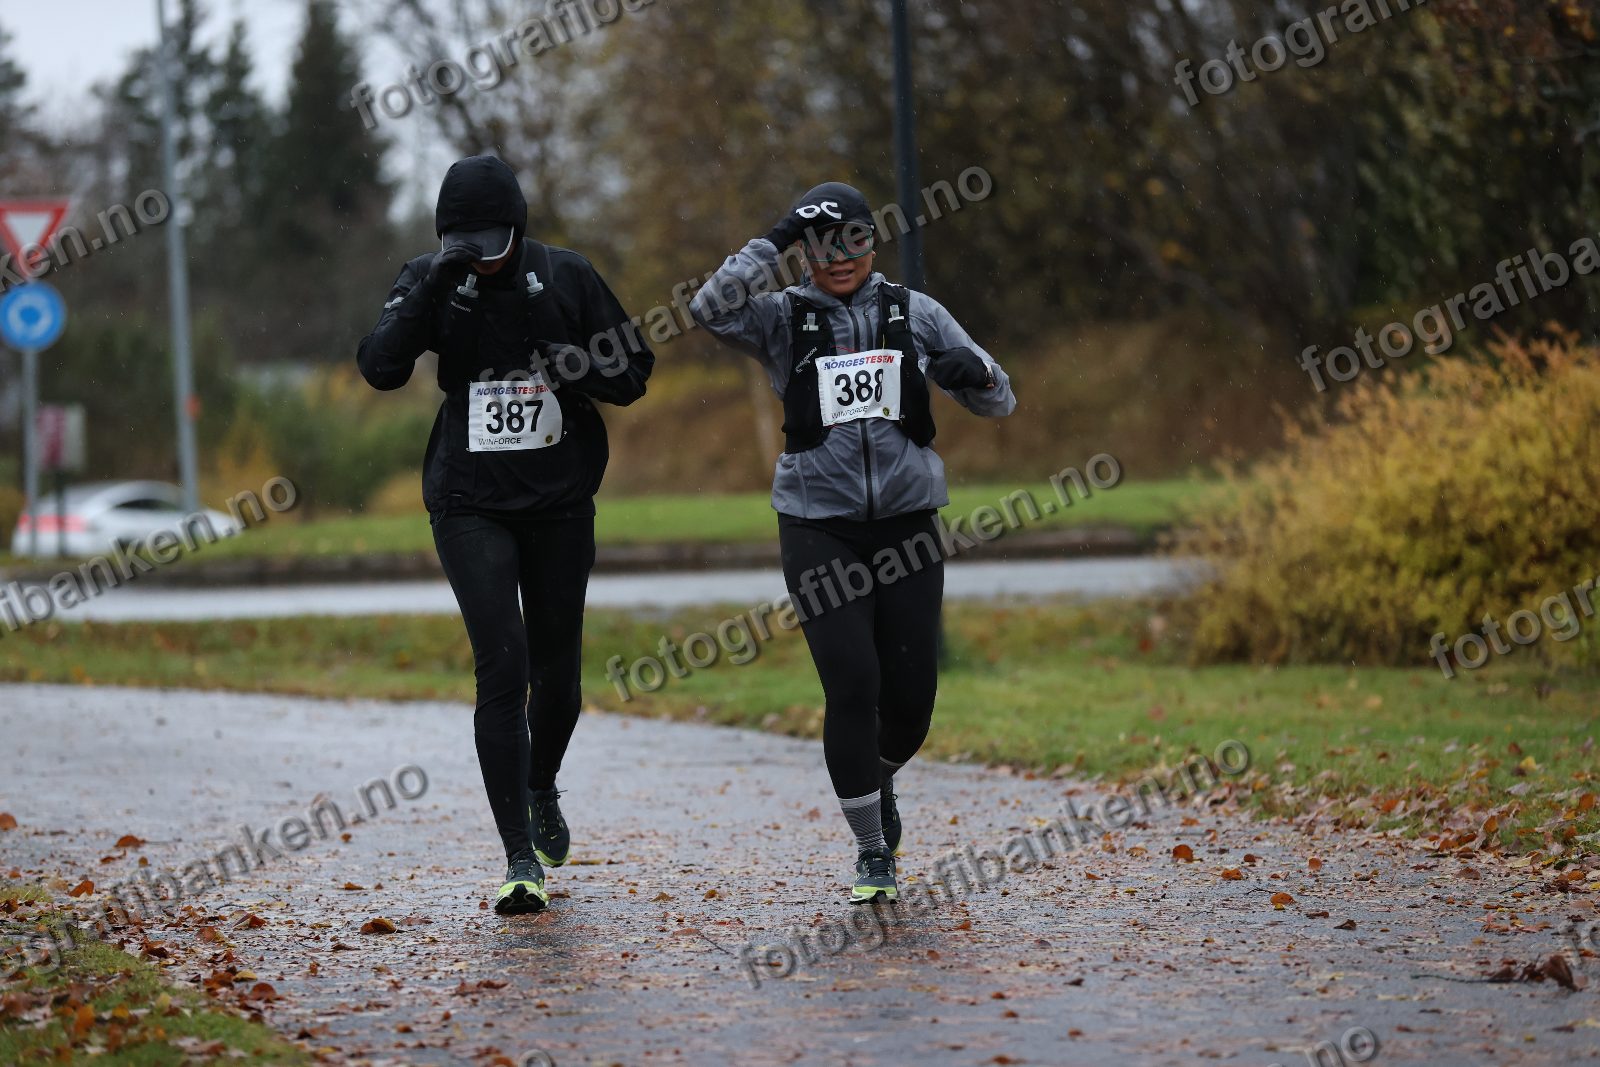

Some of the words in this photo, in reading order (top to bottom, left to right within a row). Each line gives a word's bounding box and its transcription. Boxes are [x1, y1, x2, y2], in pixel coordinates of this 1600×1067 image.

[834, 368, 884, 407] 388
[485, 399, 544, 434] 387
[478, 437, 522, 446] WINFORCE
